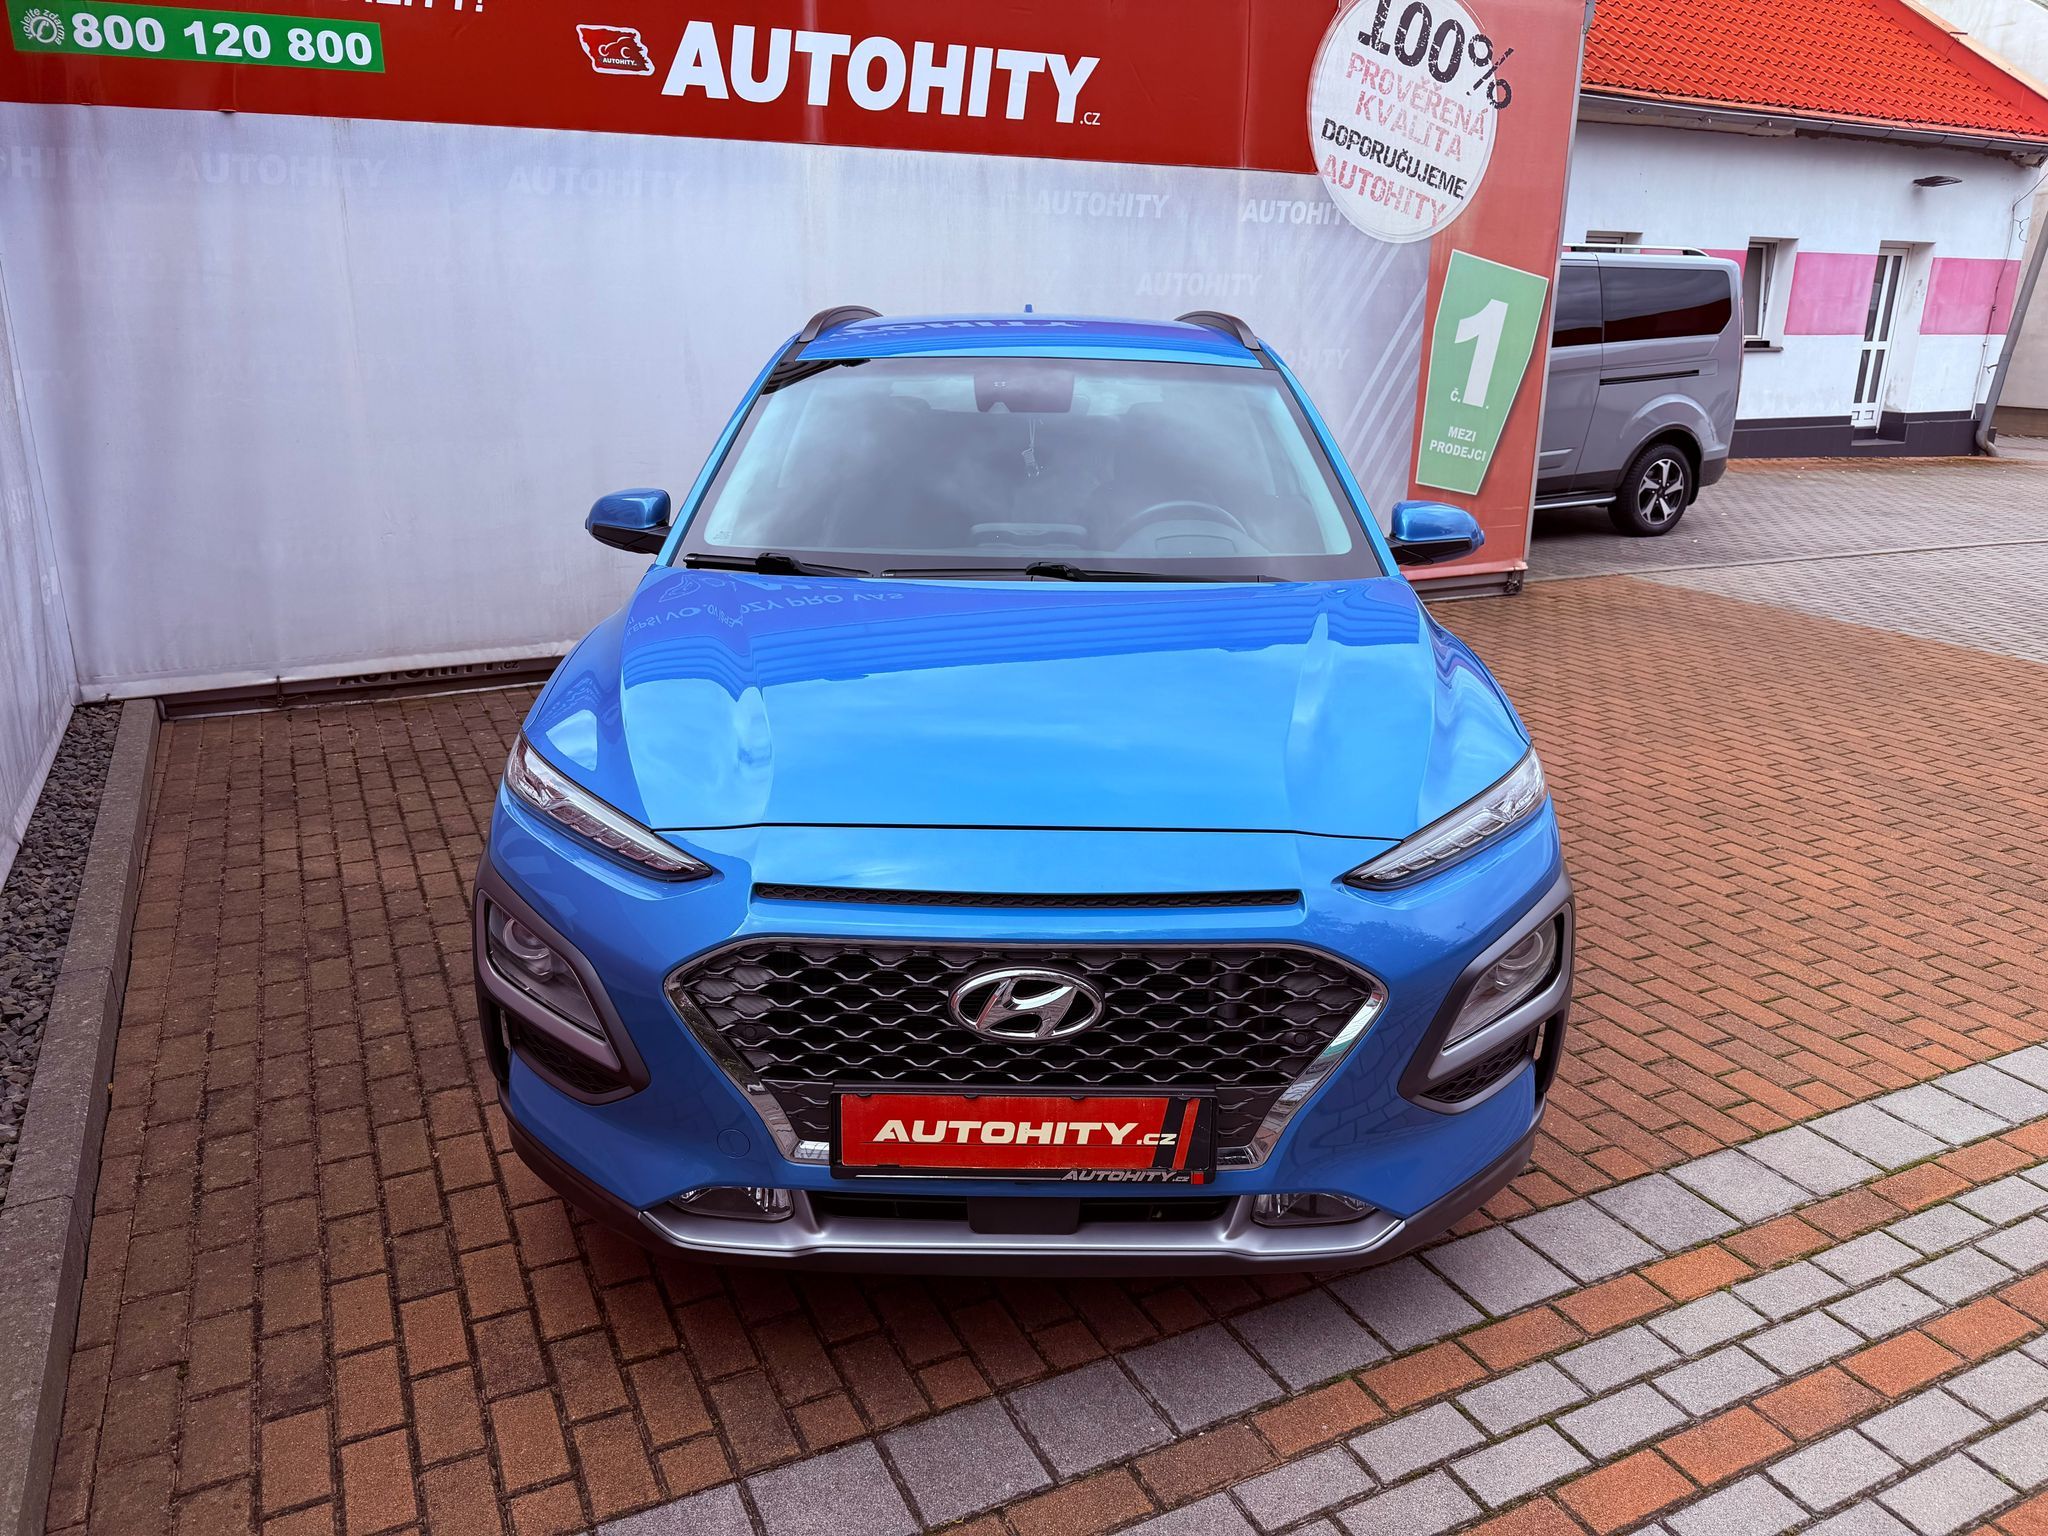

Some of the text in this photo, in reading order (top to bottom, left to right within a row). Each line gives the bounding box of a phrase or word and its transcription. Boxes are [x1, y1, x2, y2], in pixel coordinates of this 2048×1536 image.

[21, 8, 65, 45] volejte zdarma
[71, 12, 373, 66] 800 120 800
[1357, 0, 1514, 110] 100%
[1345, 52, 1489, 141] PROVĚŘENÁ
[1354, 90, 1462, 162] KVALITA
[172, 152, 388, 188] AUTOHITY
[1320, 117, 1468, 200] DOPORUČUJEME
[1036, 187, 1170, 219] AUTOHITY
[1322, 153, 1447, 228] AUTOHITY
[1240, 198, 1348, 225] AUTOHIT
[1134, 270, 1264, 298] AUTOHITY
[1429, 439, 1487, 462] PRODEJCI
[1447, 425, 1477, 442] MEZI
[872, 1119, 1177, 1146] AUTOHITY.cz
[1061, 1170, 1190, 1183] AUTOHITY.cz
